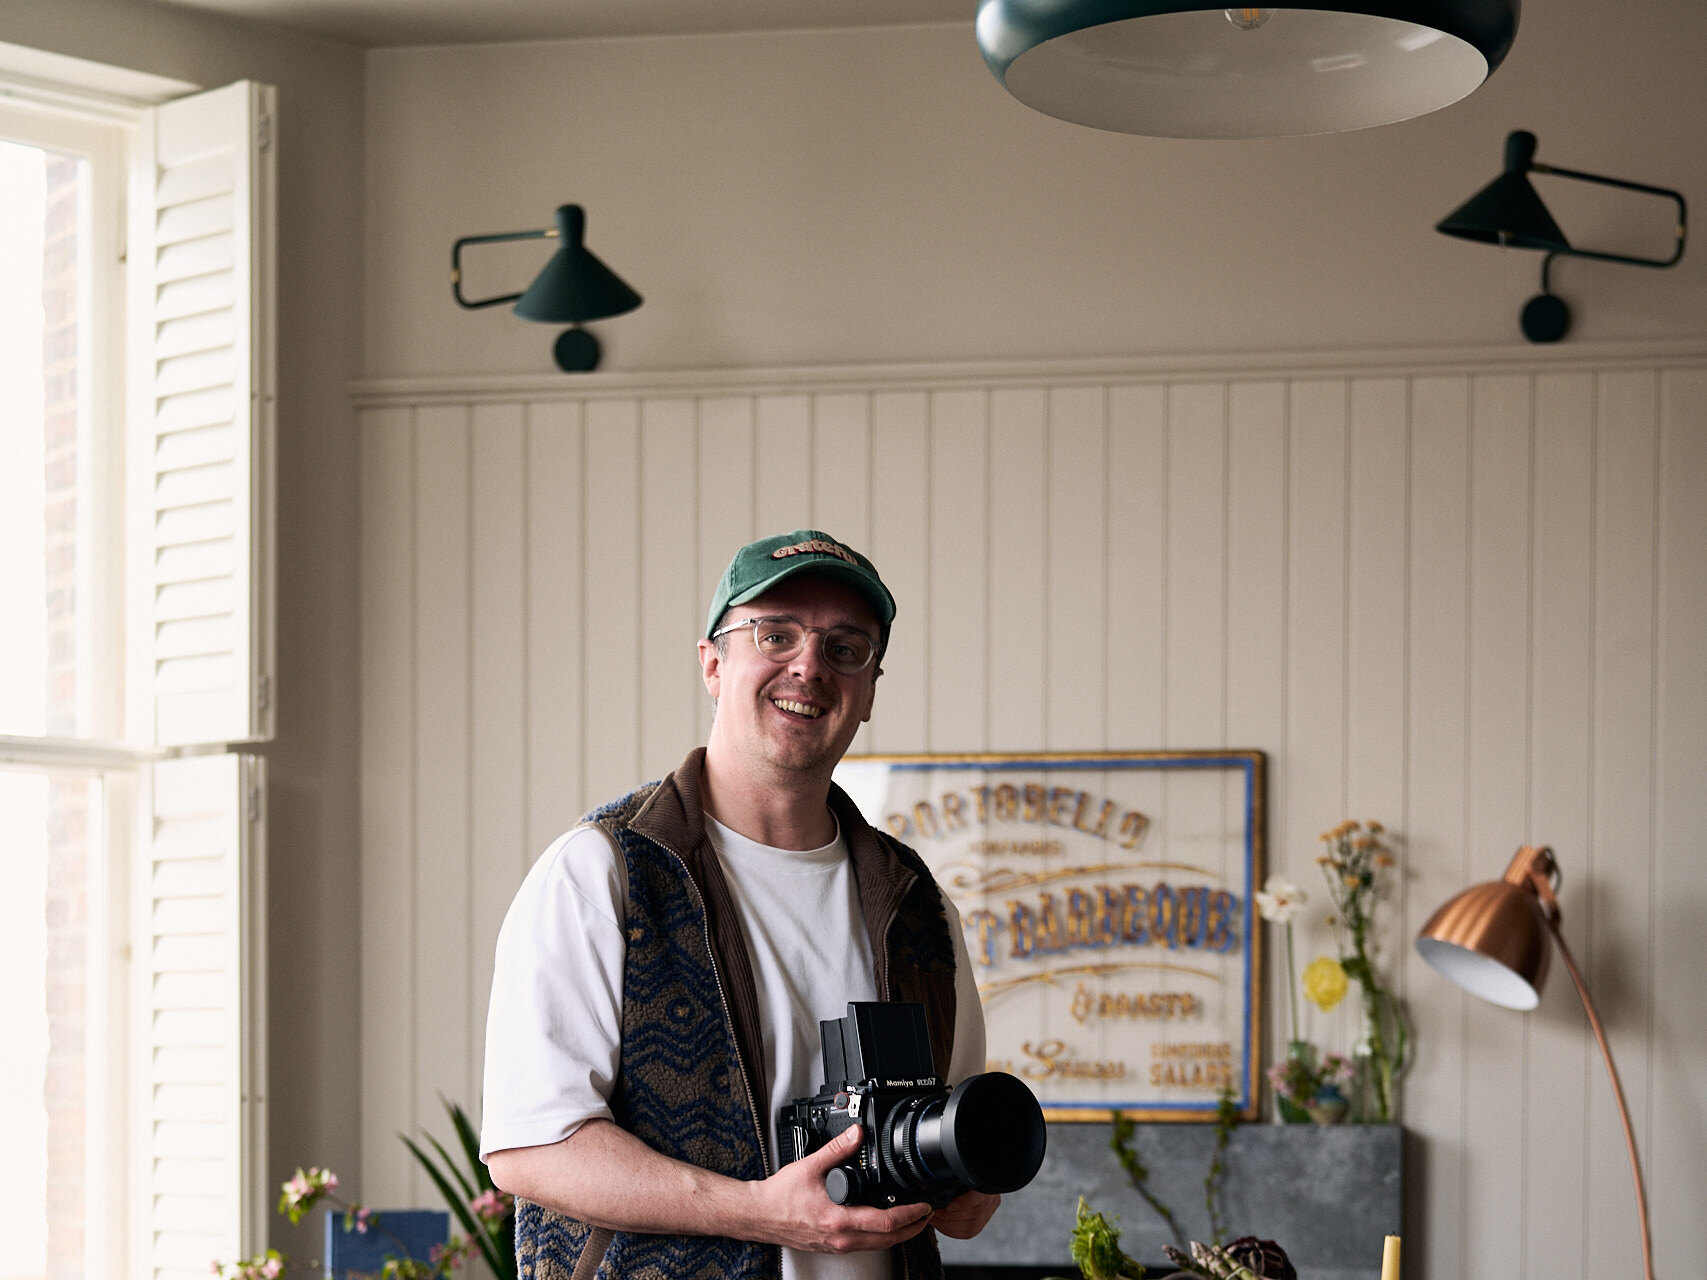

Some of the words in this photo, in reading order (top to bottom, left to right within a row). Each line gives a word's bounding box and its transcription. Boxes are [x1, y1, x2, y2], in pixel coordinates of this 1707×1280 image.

[885, 783, 1150, 850] PORTOBELLO
[1006, 882, 1236, 960] BARBEQUE
[886, 1079, 914, 1088] Mamiya
